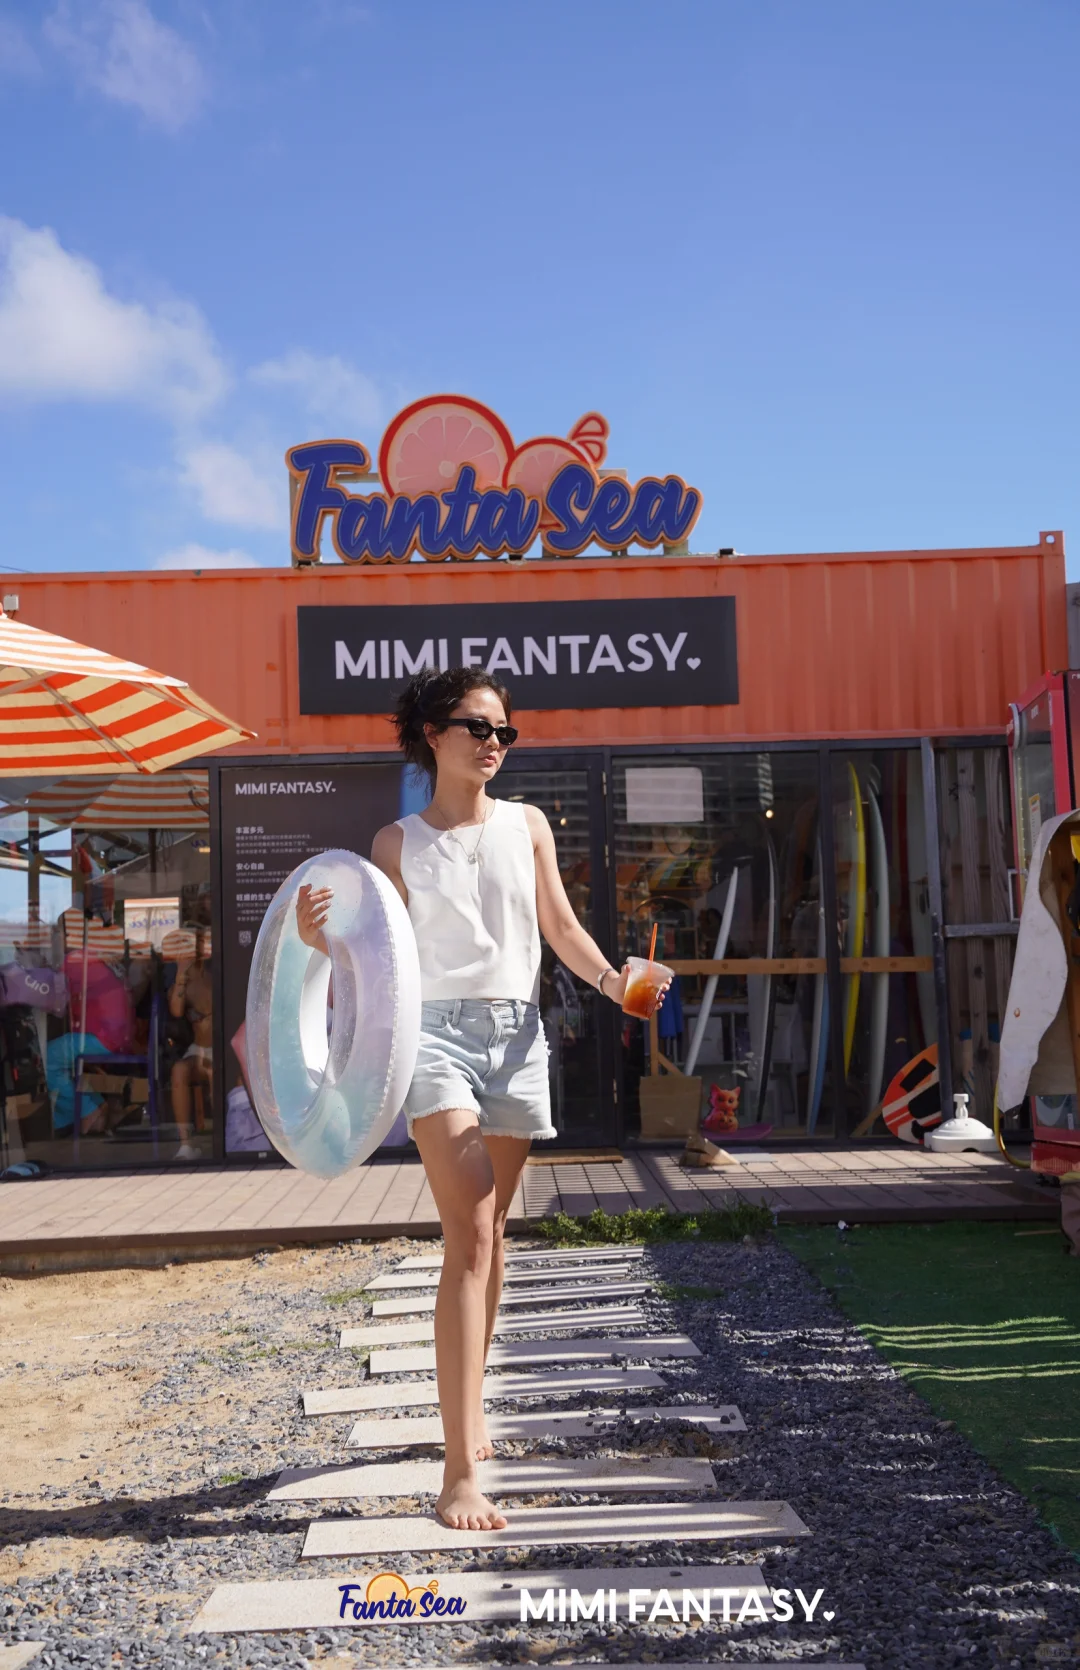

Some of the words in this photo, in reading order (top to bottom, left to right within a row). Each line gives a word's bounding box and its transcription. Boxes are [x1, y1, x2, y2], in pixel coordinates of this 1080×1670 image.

[290, 443, 539, 561] Fanta
[546, 464, 699, 549] Sea
[334, 639, 447, 679] MIMI
[462, 632, 688, 676] FANTASY
[235, 783, 267, 795] MIMI
[270, 781, 332, 795] FANTASY
[236, 826, 264, 834] 丰富多元
